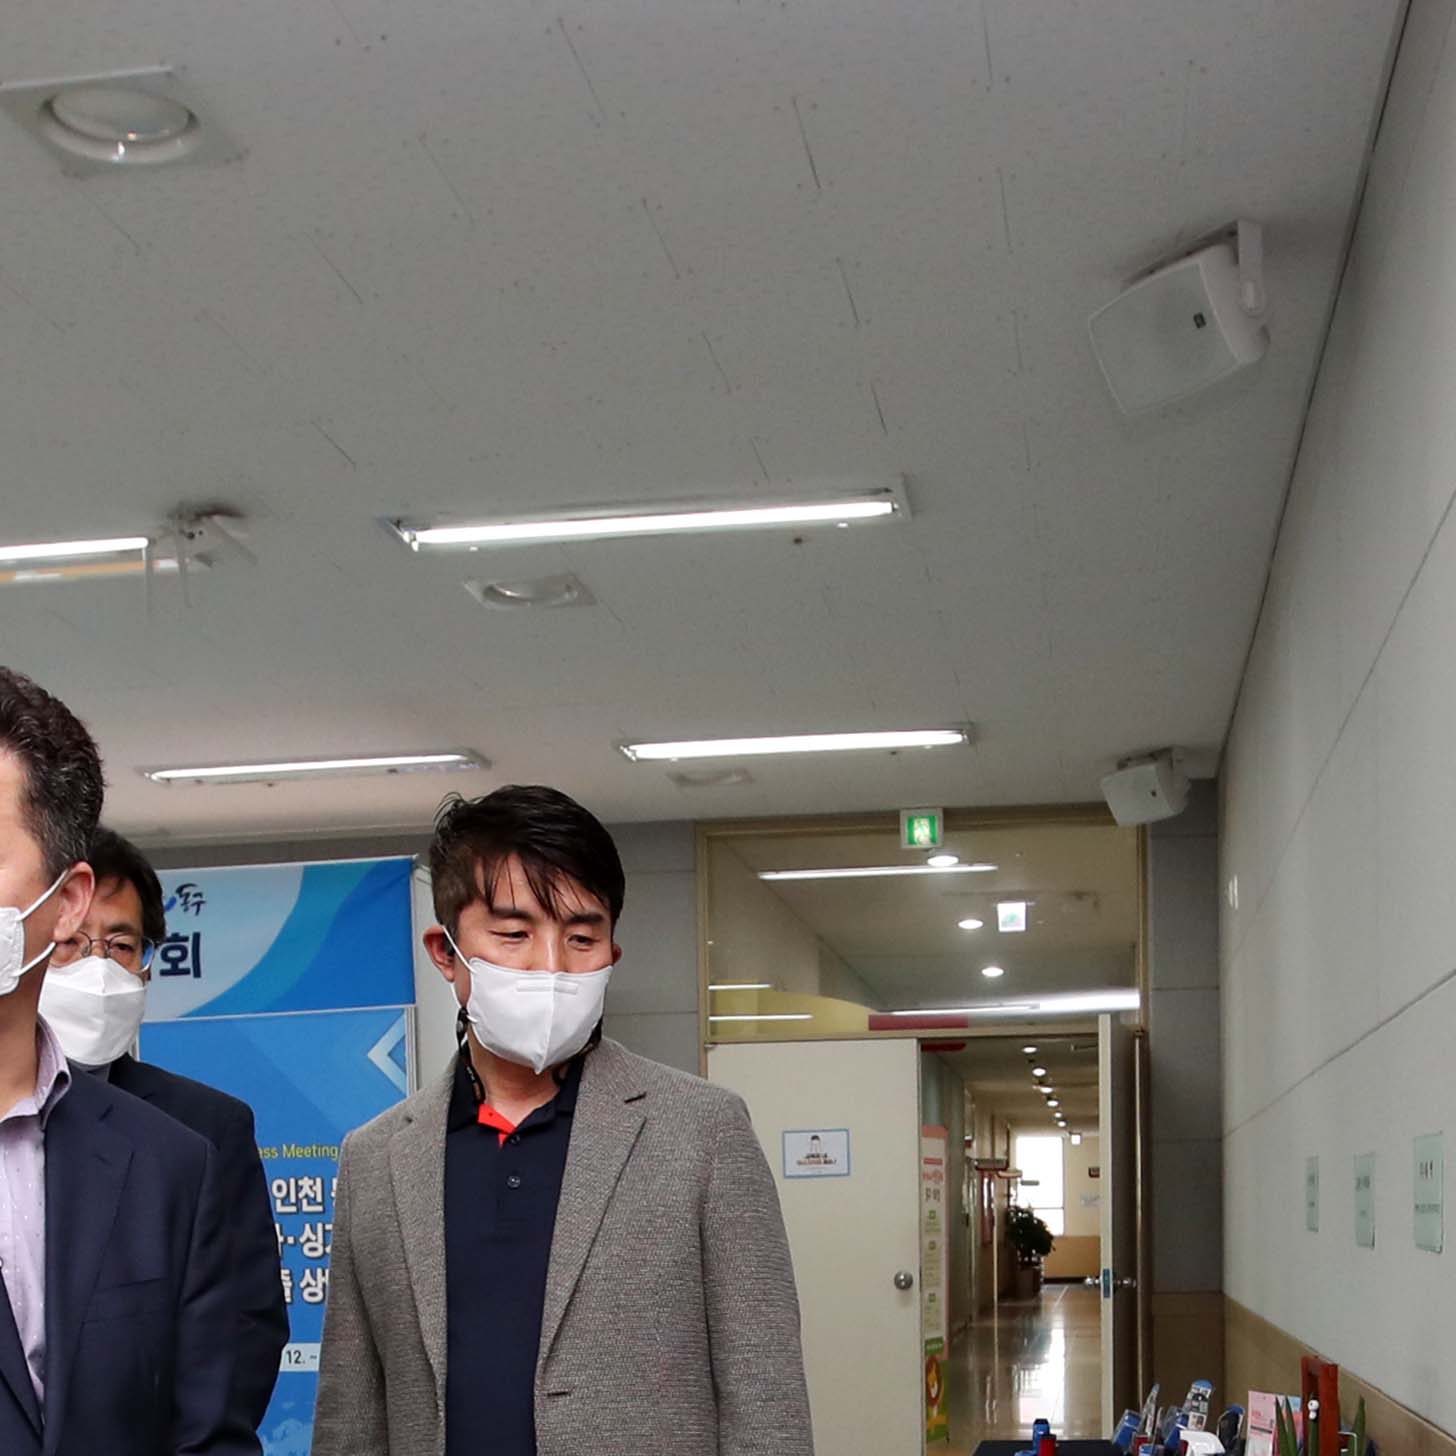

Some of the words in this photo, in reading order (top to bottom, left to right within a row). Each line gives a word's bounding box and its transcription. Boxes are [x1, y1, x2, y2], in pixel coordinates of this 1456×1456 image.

[159, 931, 203, 979] 회
[282, 1143, 339, 1161] Meeting
[271, 1176, 325, 1214] 인천
